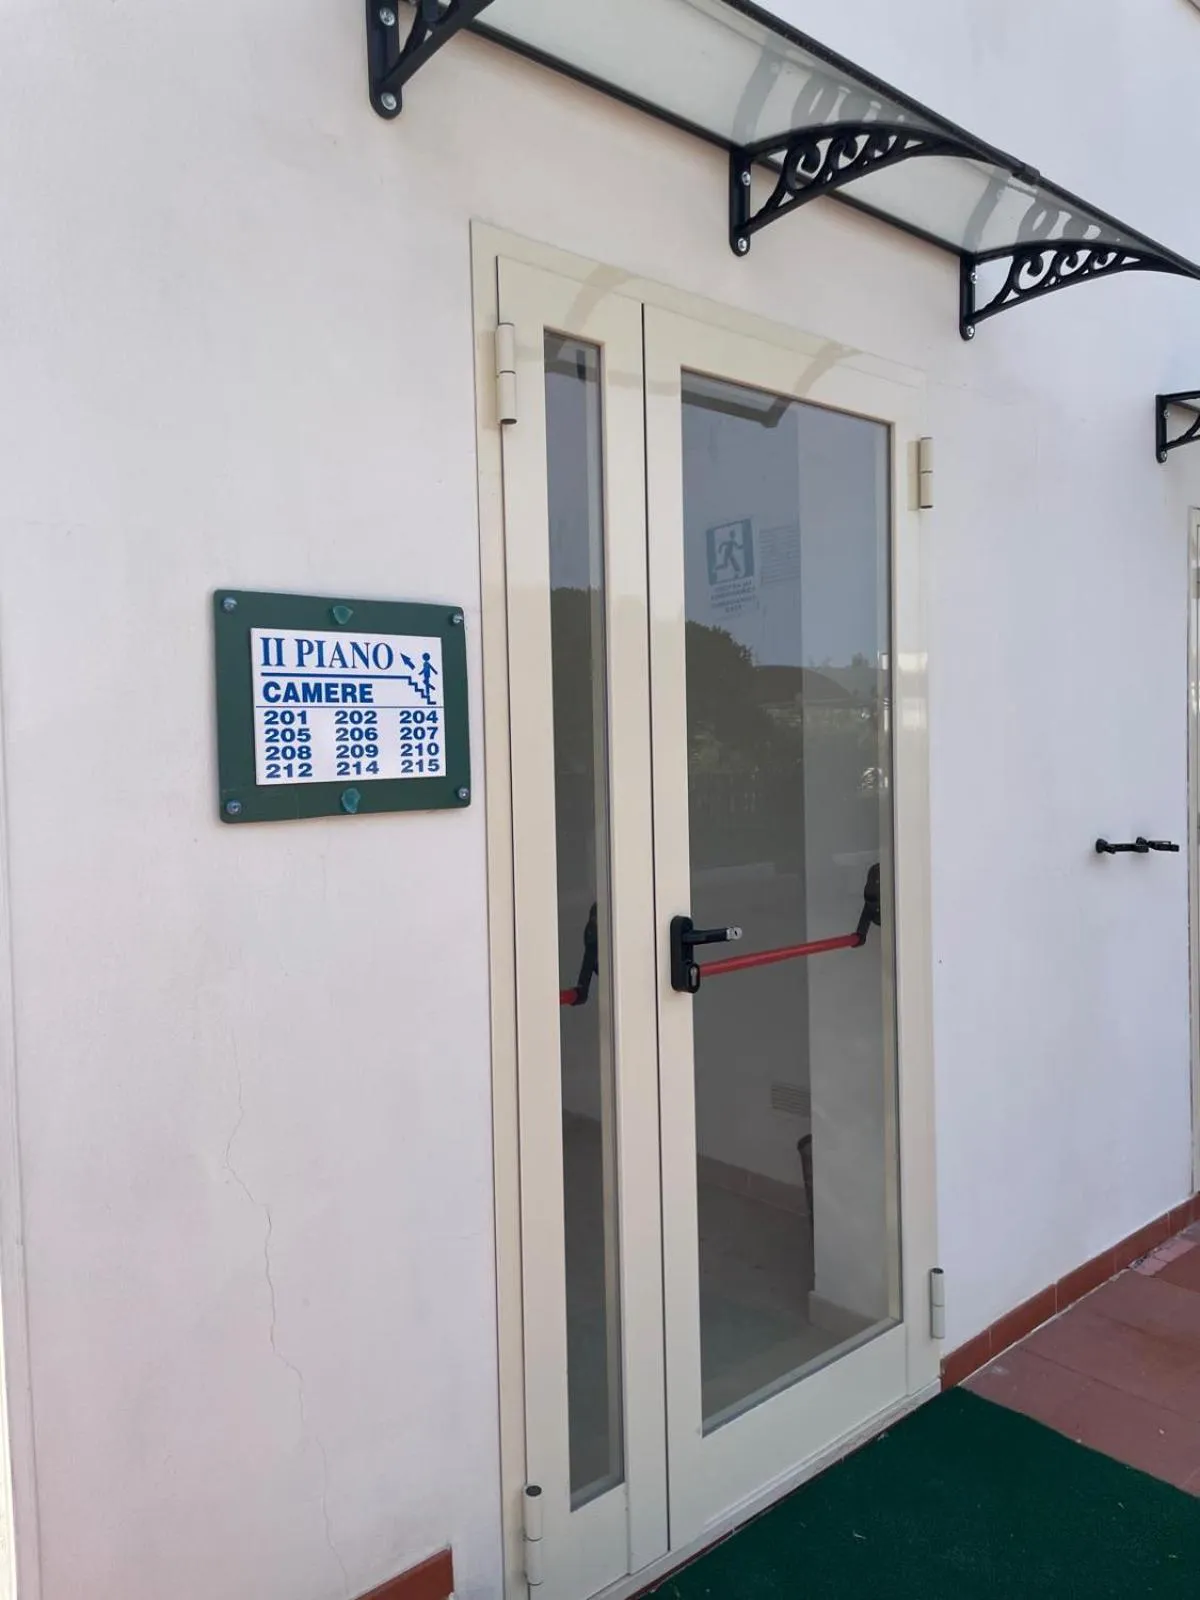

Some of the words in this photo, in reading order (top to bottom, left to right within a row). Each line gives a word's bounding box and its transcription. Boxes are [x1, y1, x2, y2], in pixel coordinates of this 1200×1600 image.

[295, 638, 394, 670] PIANO
[263, 681, 374, 703] CAMERE
[264, 710, 307, 725] 201
[335, 710, 377, 724] 202
[399, 710, 438, 723] 204
[264, 728, 311, 743] 205
[335, 728, 378, 741] 206
[400, 727, 438, 740] 207
[265, 746, 312, 760] 208
[336, 744, 379, 758] 209
[400, 743, 439, 757] 210
[265, 763, 312, 778] 212
[337, 761, 379, 775] 214
[401, 759, 440, 773] 215
